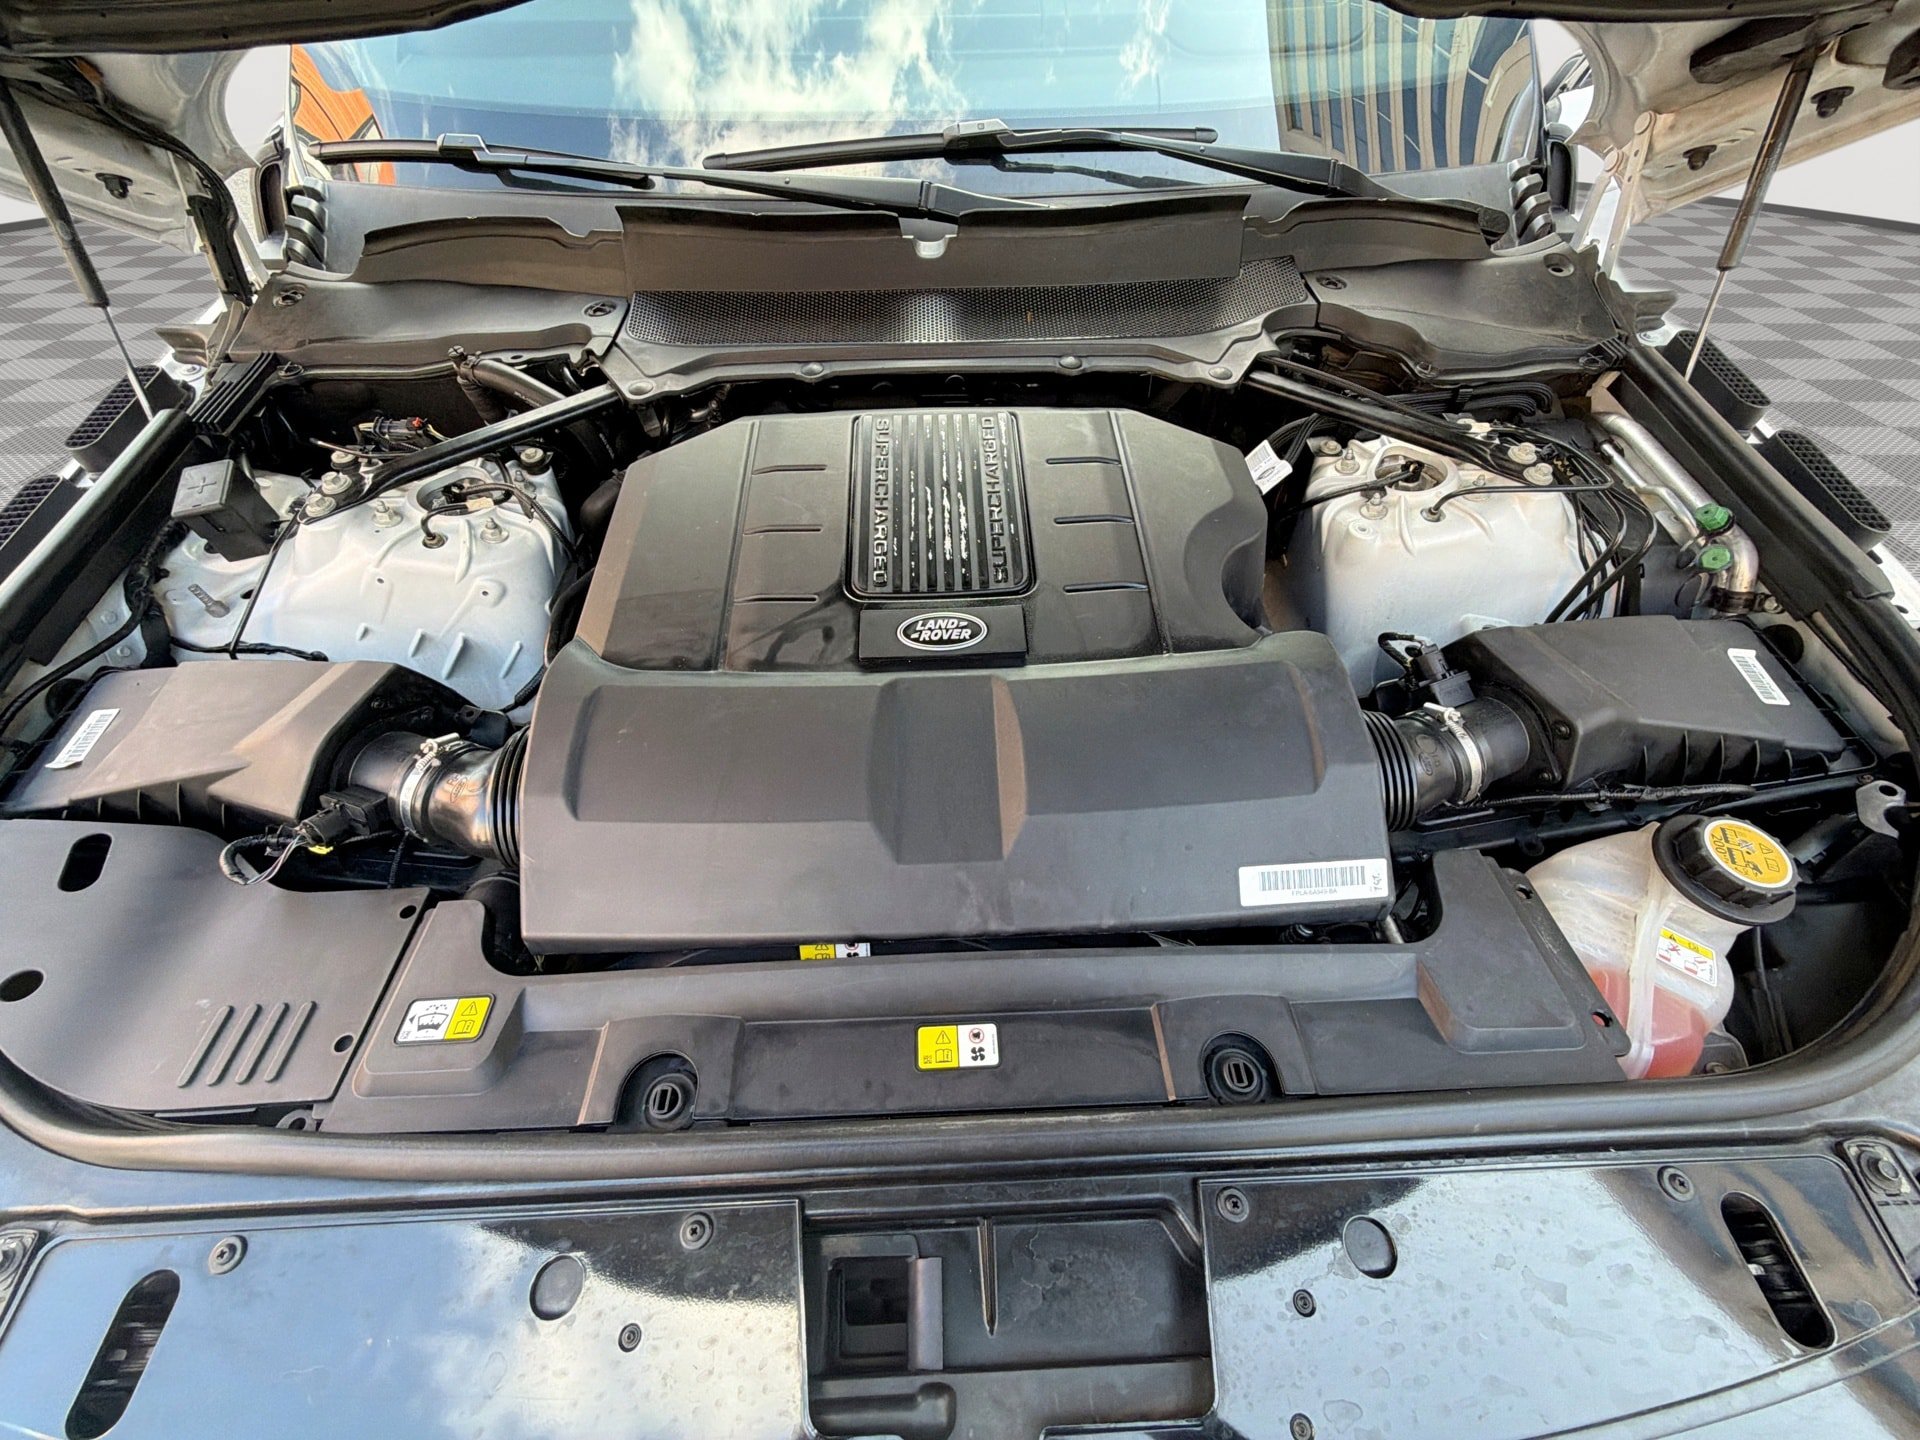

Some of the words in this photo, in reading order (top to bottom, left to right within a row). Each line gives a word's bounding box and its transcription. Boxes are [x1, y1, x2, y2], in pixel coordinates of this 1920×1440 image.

[873, 418, 890, 588] SUPERCHARGED
[981, 416, 1009, 584] SUPERCHARGED
[916, 618, 958, 630] LAND
[919, 628, 972, 641] ROVER
